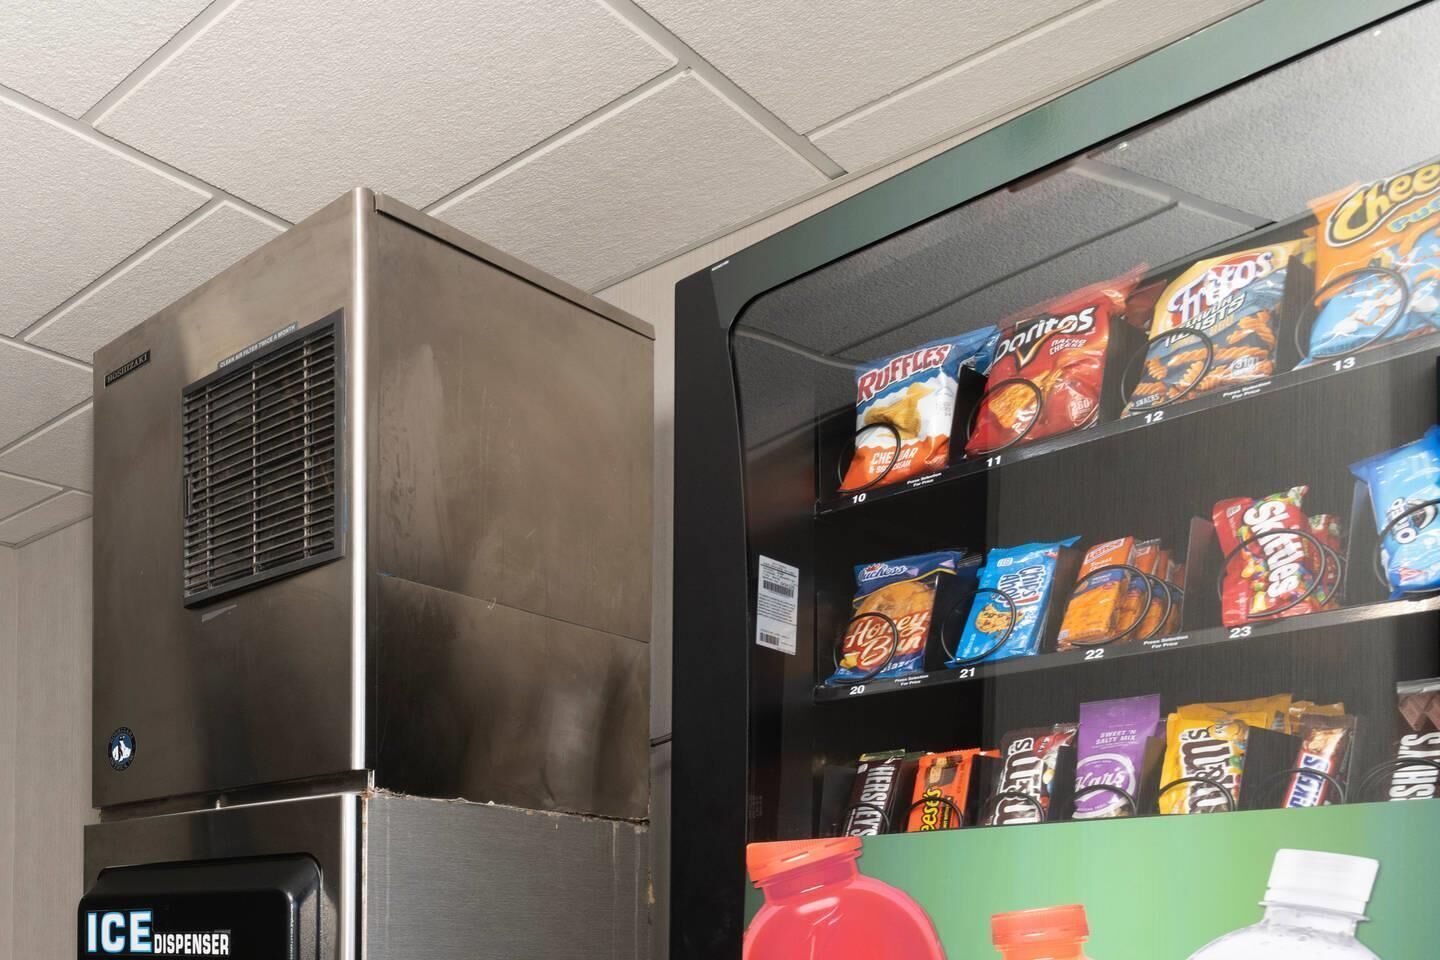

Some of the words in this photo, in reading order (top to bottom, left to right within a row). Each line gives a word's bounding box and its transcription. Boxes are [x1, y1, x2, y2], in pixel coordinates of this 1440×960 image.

[1167, 251, 1273, 325] Fritos
[994, 306, 1096, 364] Doritos
[1332, 357, 1356, 371] 13
[857, 344, 951, 405] RUFFLES
[1144, 411, 1164, 424] 12
[872, 448, 918, 466] CHEDAR
[986, 455, 1002, 467] 11
[852, 493, 867, 504] 10
[1244, 500, 1304, 597] Skittles
[1018, 565, 1045, 598] Chips
[1229, 626, 1252, 639] 23
[1084, 648, 1104, 660] 22
[959, 667, 975, 678] 21
[849, 685, 865, 695] 20
[1095, 737, 1119, 745] SALTY
[1100, 731, 1126, 739] SWEET
[1388, 731, 1440, 801] SHY'S
[1075, 768, 1128, 791] Kar's
[850, 766, 896, 836] HERSHEY'S
[87, 910, 152, 953] ICE
[153, 933, 229, 955] DISPENSER
